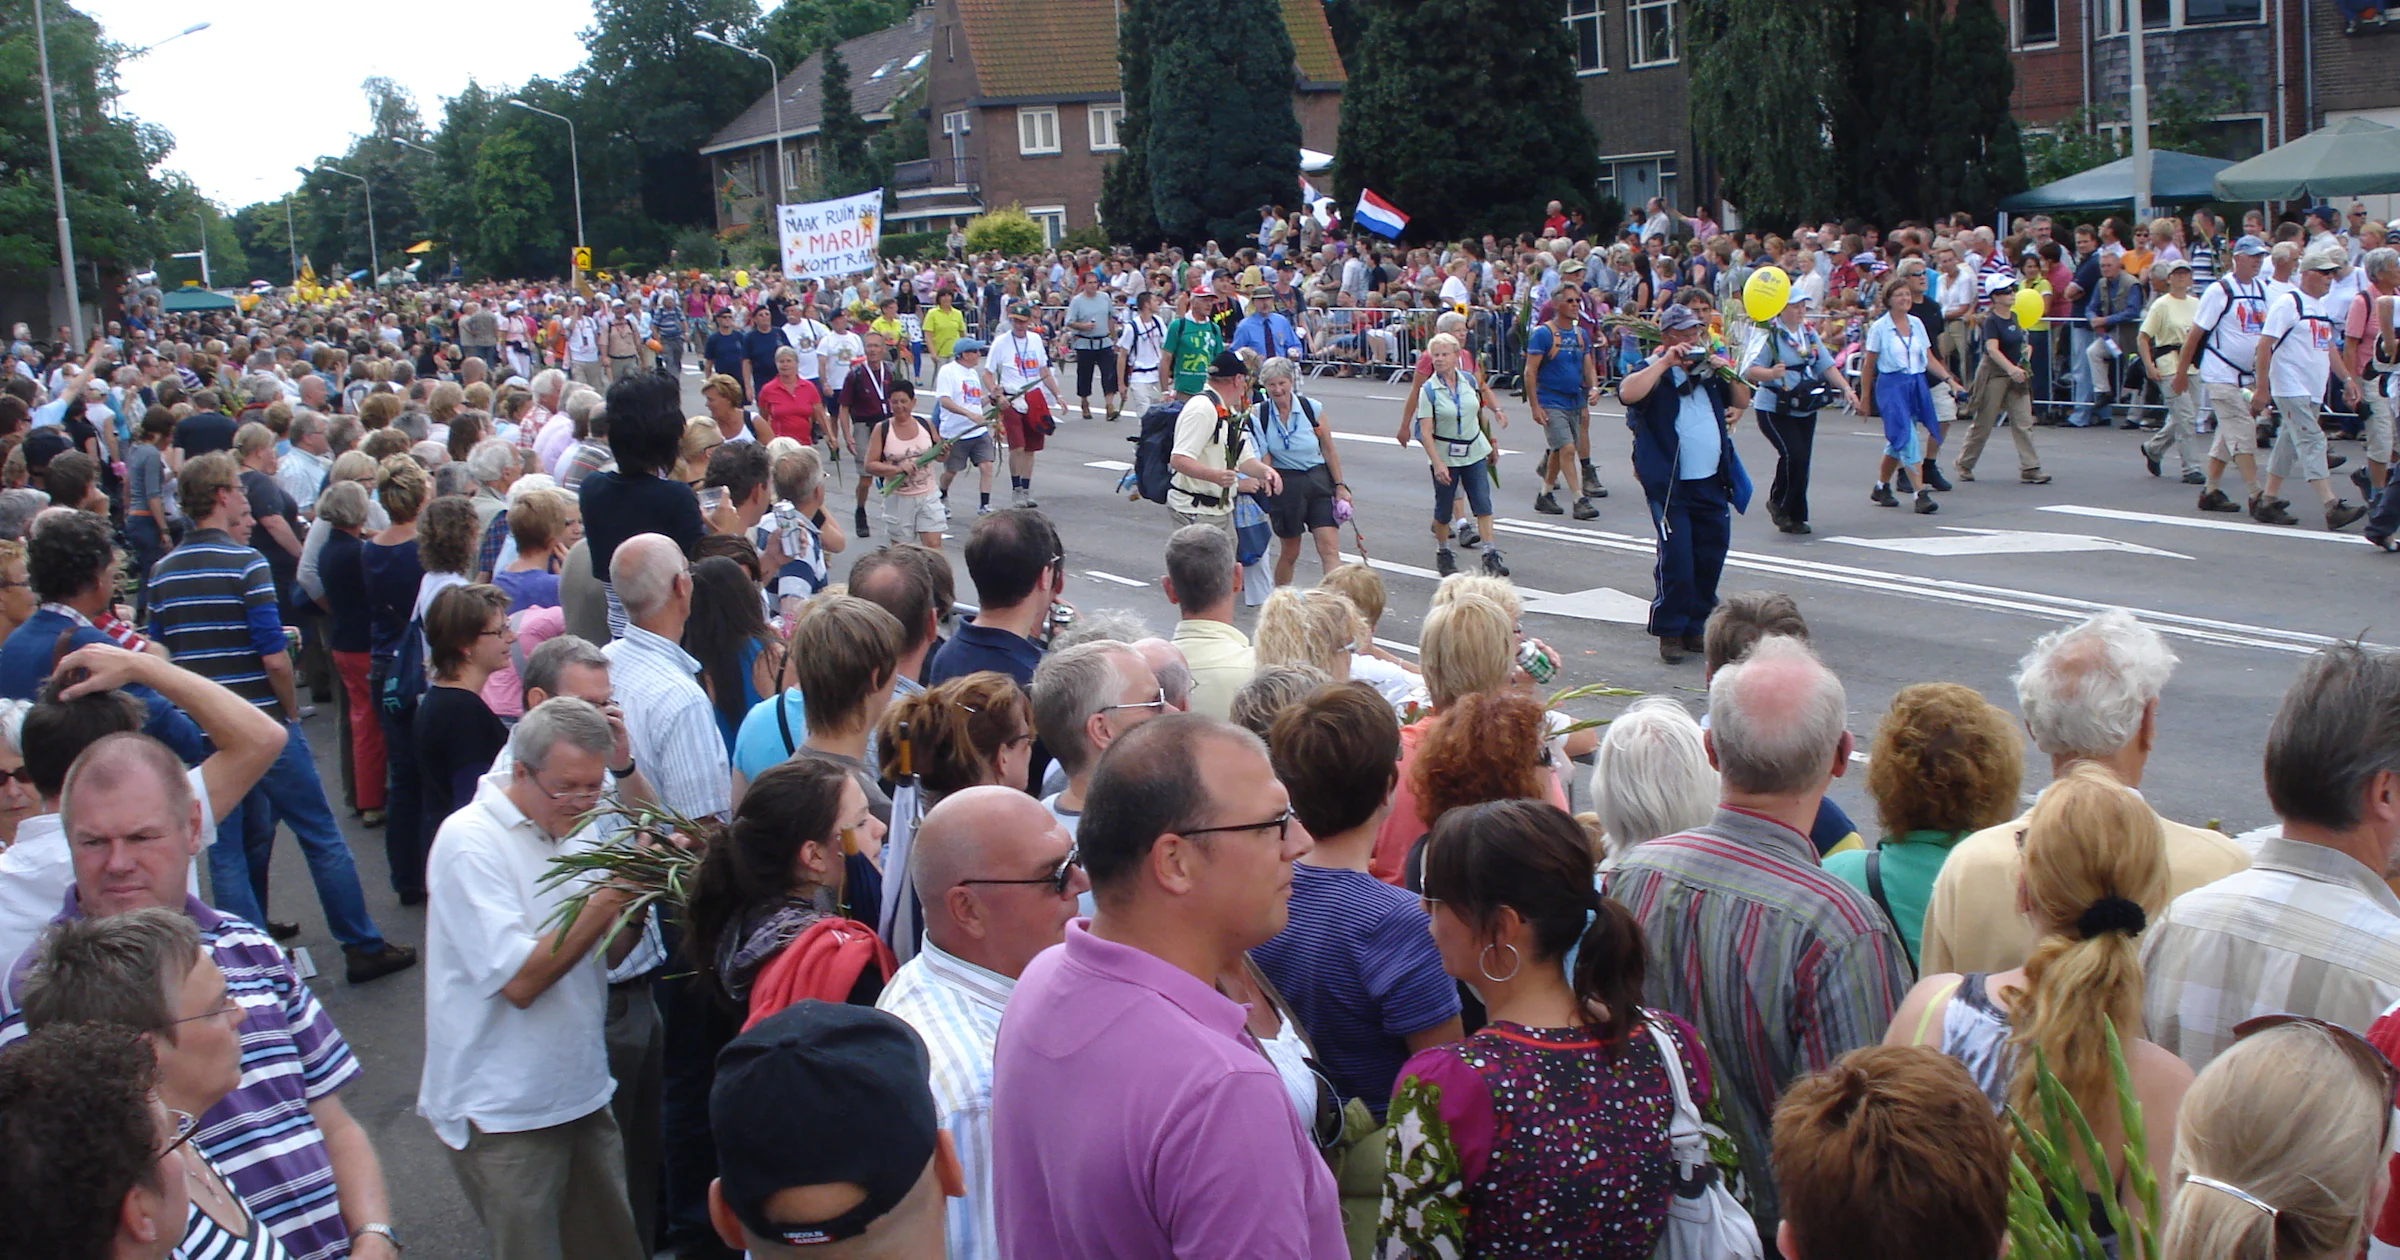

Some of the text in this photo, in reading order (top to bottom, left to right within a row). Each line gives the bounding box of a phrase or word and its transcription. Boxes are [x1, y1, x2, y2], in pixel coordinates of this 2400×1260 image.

[785, 216, 819, 233] MAAK
[809, 226, 873, 254] MARIA
[800, 256, 840, 273] KOMT
